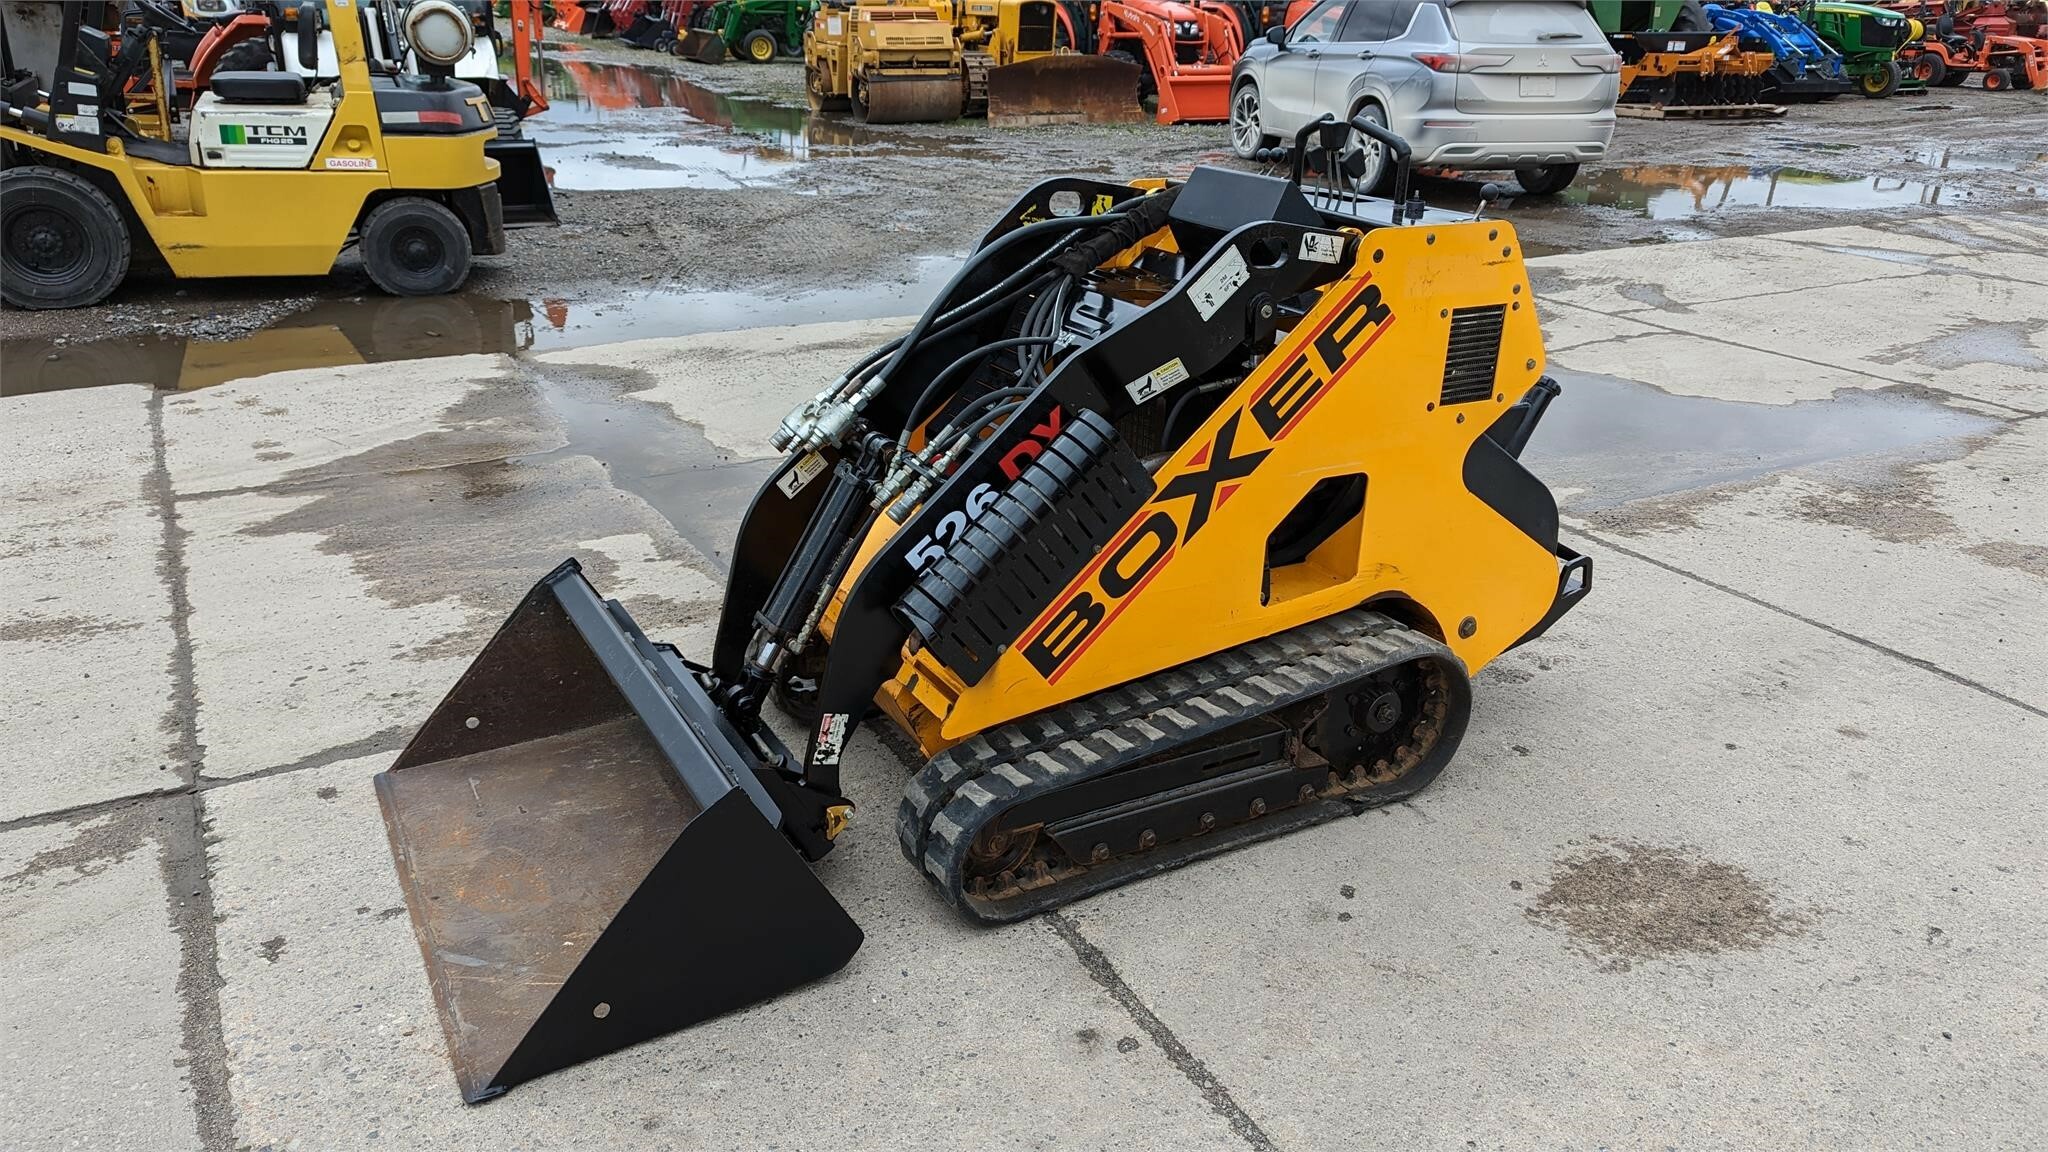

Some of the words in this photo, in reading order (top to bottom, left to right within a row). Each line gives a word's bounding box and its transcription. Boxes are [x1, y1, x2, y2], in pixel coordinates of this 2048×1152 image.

[245, 125, 307, 136] TCM
[329, 159, 373, 168] GASOLINE
[1021, 284, 1393, 680] BOXER
[904, 482, 999, 577] 526
